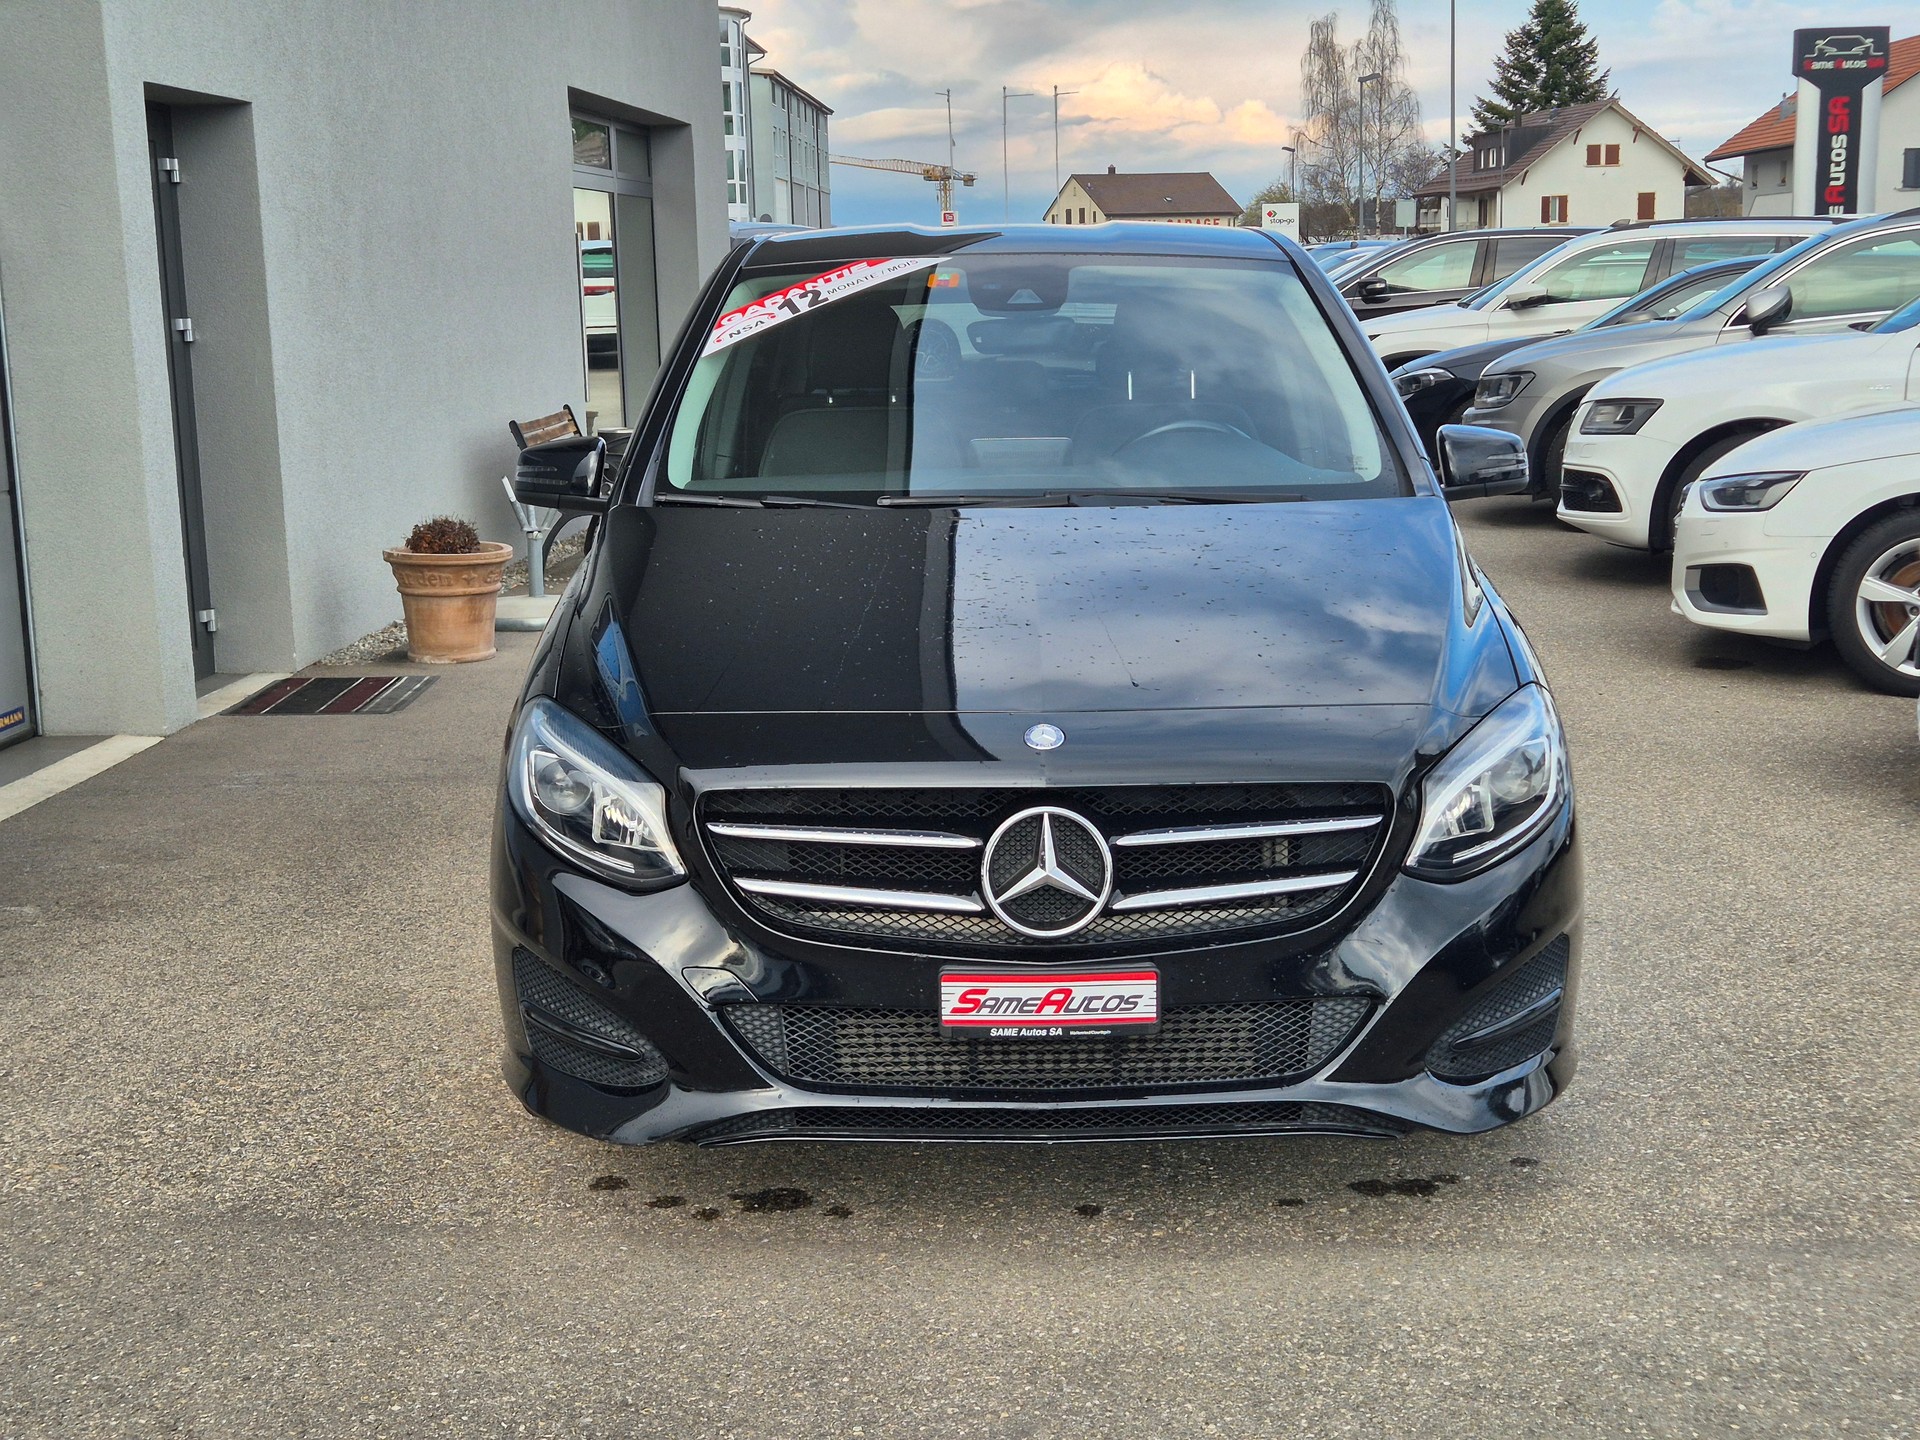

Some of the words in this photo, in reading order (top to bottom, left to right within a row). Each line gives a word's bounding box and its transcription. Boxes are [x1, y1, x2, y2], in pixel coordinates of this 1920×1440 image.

[720, 261, 868, 326] GARANTIE
[729, 316, 765, 338] NSA
[777, 289, 829, 315] 12
[826, 272, 879, 295] MONATE
[887, 259, 919, 273] MOIS
[990, 1027, 1019, 1037] SAME
[1020, 1027, 1048, 1037] Autos
[1049, 1027, 1063, 1036] SA
